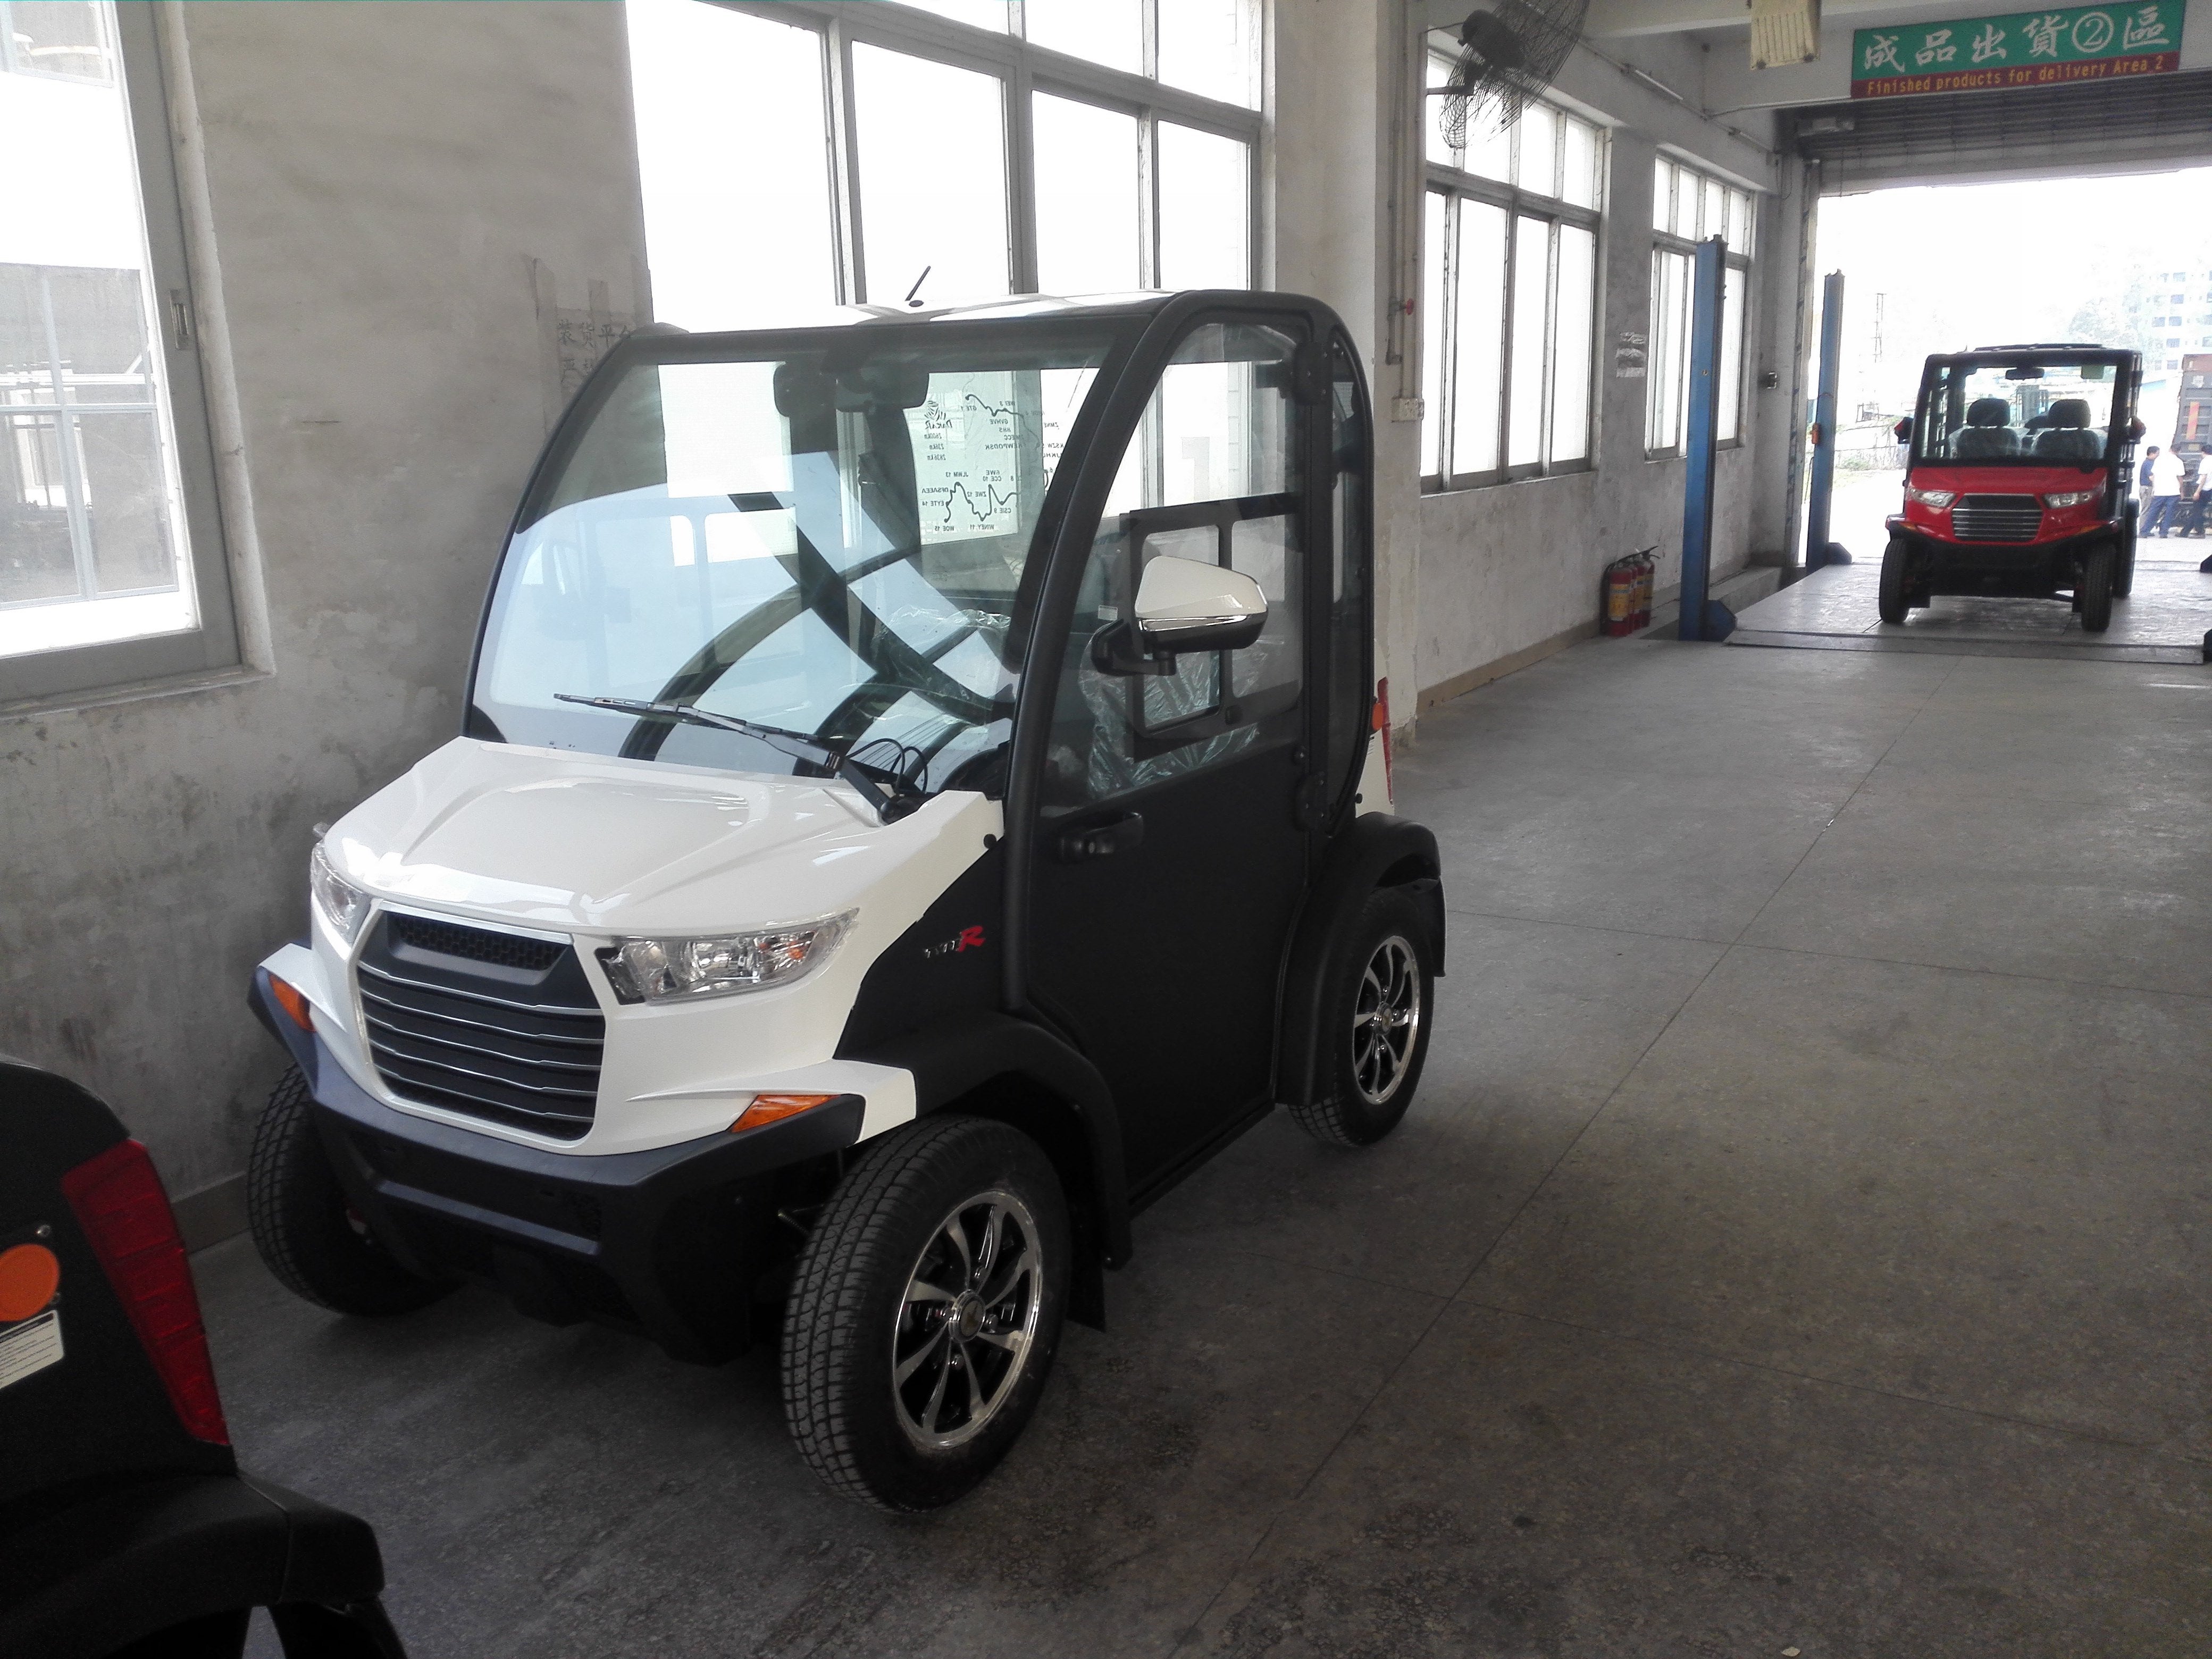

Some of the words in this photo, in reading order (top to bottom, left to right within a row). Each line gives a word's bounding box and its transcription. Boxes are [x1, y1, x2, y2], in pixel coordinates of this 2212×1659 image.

[1867, 76, 1930, 95] Finished
[1936, 72, 2001, 91] products
[2009, 68, 2032, 83] for
[2039, 60, 2106, 81] delivery
[2114, 57, 2148, 73] Area
[2156, 55, 2164, 70] 2
